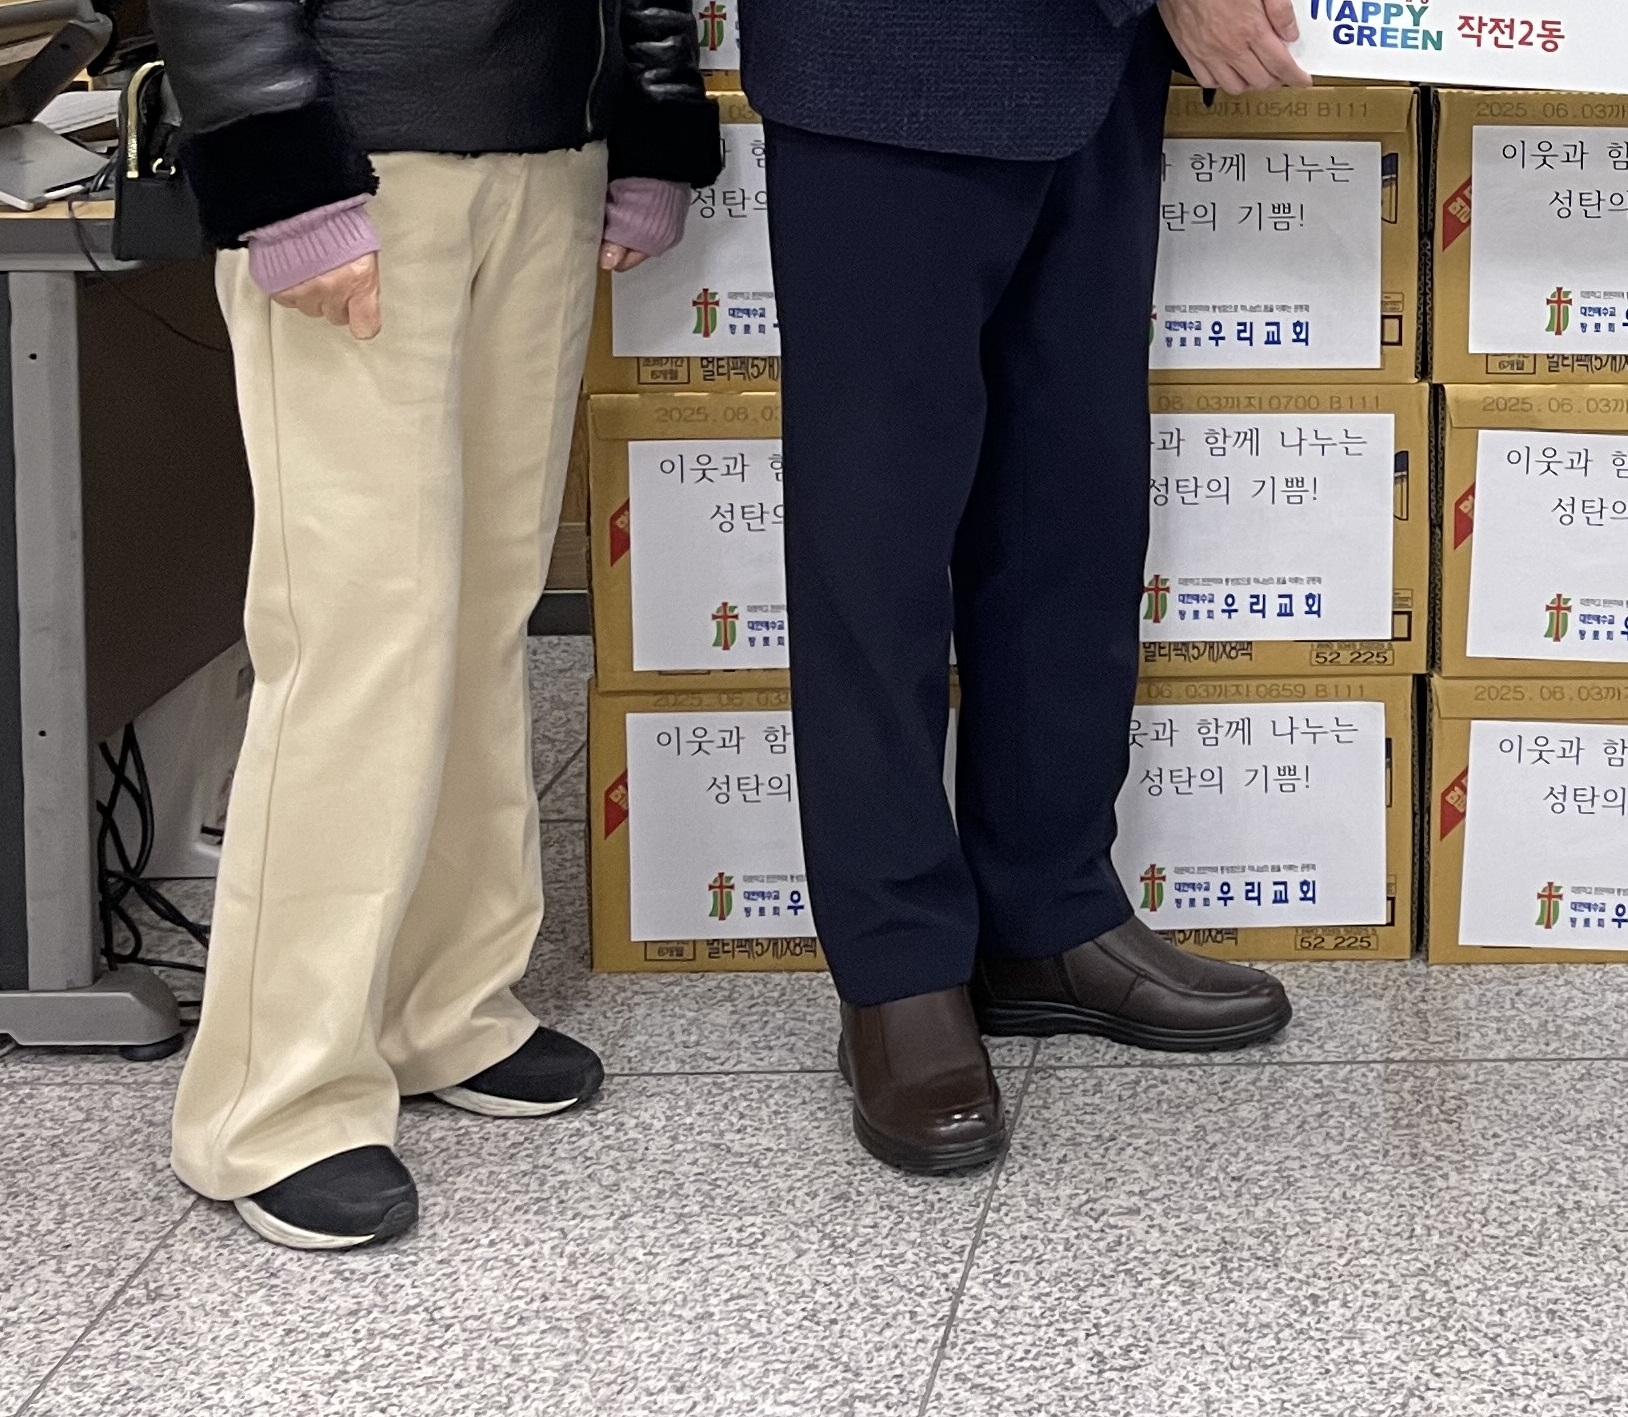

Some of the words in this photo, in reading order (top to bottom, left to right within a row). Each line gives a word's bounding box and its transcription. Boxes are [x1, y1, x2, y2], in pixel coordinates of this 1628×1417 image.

[1333, 24, 1443, 51] GREEN
[1456, 14, 1565, 53] 작전2동
[1188, 151, 1246, 183] 함께
[1265, 152, 1355, 183] 나누는
[1502, 139, 1590, 171] 이웃과
[1162, 202, 1216, 230] 탄의
[1237, 201, 1304, 232] 기쁨!
[1207, 319, 1310, 348] 우리교회
[1203, 426, 1260, 457] 함께
[1279, 426, 1368, 457] 나누는
[659, 452, 751, 485] 이웃과
[1506, 445, 1594, 478] 이웃과
[1150, 476, 1229, 506] 성탄의
[1251, 475, 1318, 506] 기쁨!
[1220, 592, 1322, 620] 우리교회
[1314, 652, 1341, 664] 52
[1349, 652, 1389, 665] 225
[656, 725, 746, 757] 이웃과
[1196, 716, 1252, 747] 함께
[1270, 715, 1359, 746] 나누는
[1498, 734, 1586, 766] 이웃과
[707, 774, 792, 803] 성탄의
[1140, 764, 1224, 796] 성탄의
[1244, 764, 1310, 794] 기쁨!
[1542, 784, 1626, 817] 성탄의
[1216, 878, 1317, 908] 우리교회
[1334, 936, 1372, 948] 225
